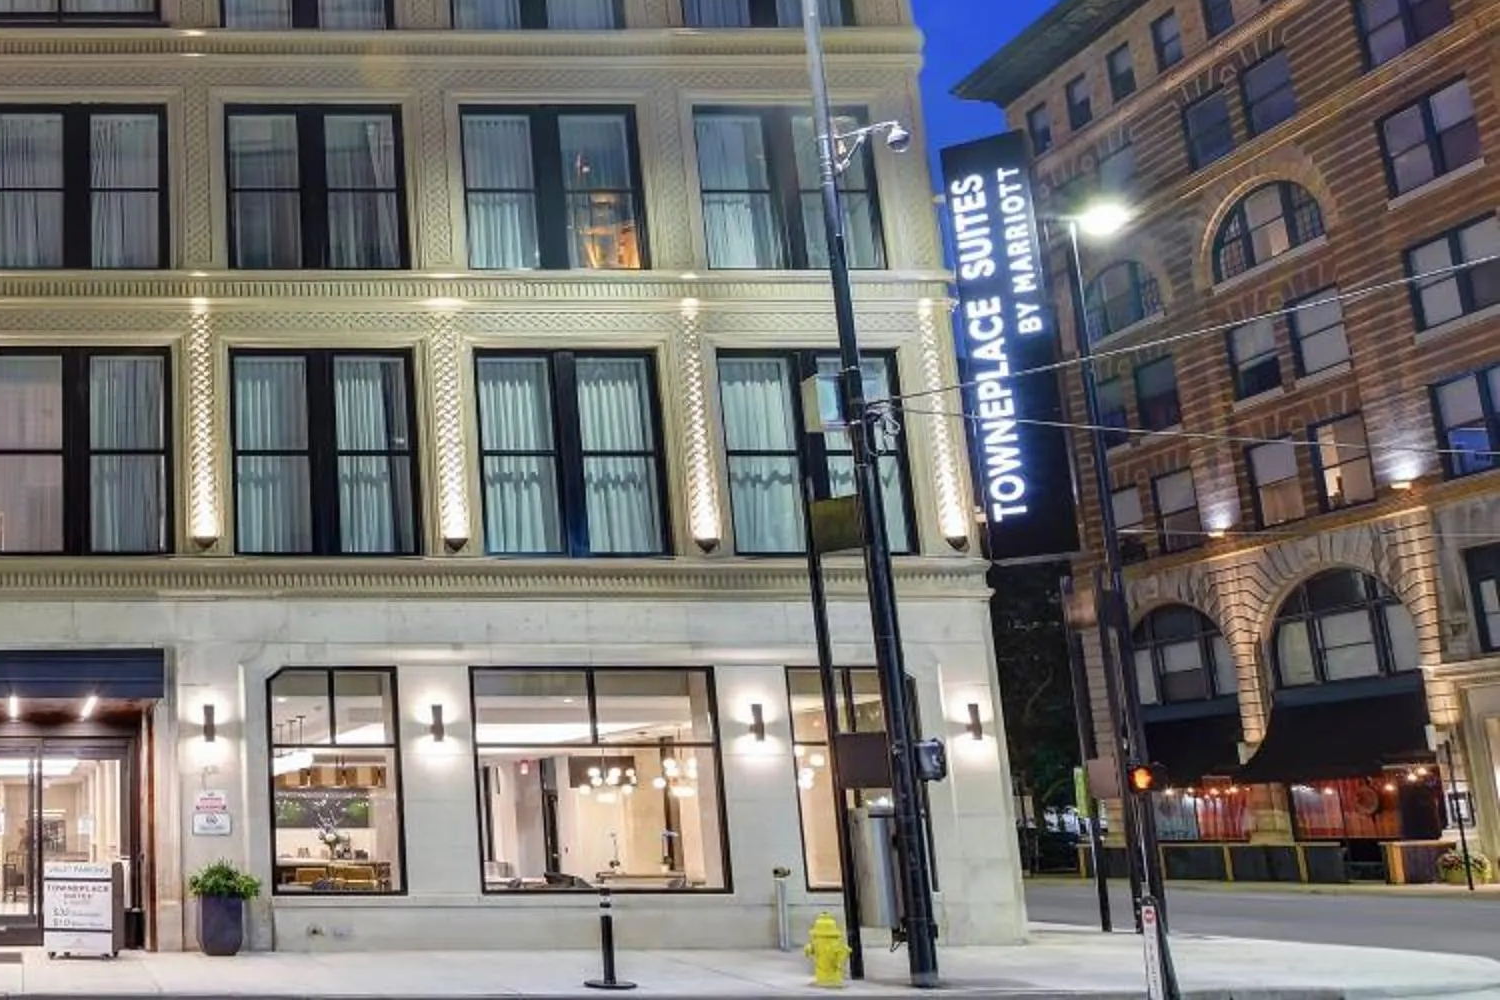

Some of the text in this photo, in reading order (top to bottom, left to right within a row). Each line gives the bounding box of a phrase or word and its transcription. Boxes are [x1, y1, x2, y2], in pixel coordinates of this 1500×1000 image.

[951, 174, 1028, 522] TOWNEPLACE SUITES
[997, 167, 1043, 334] BY MARRIOTT
